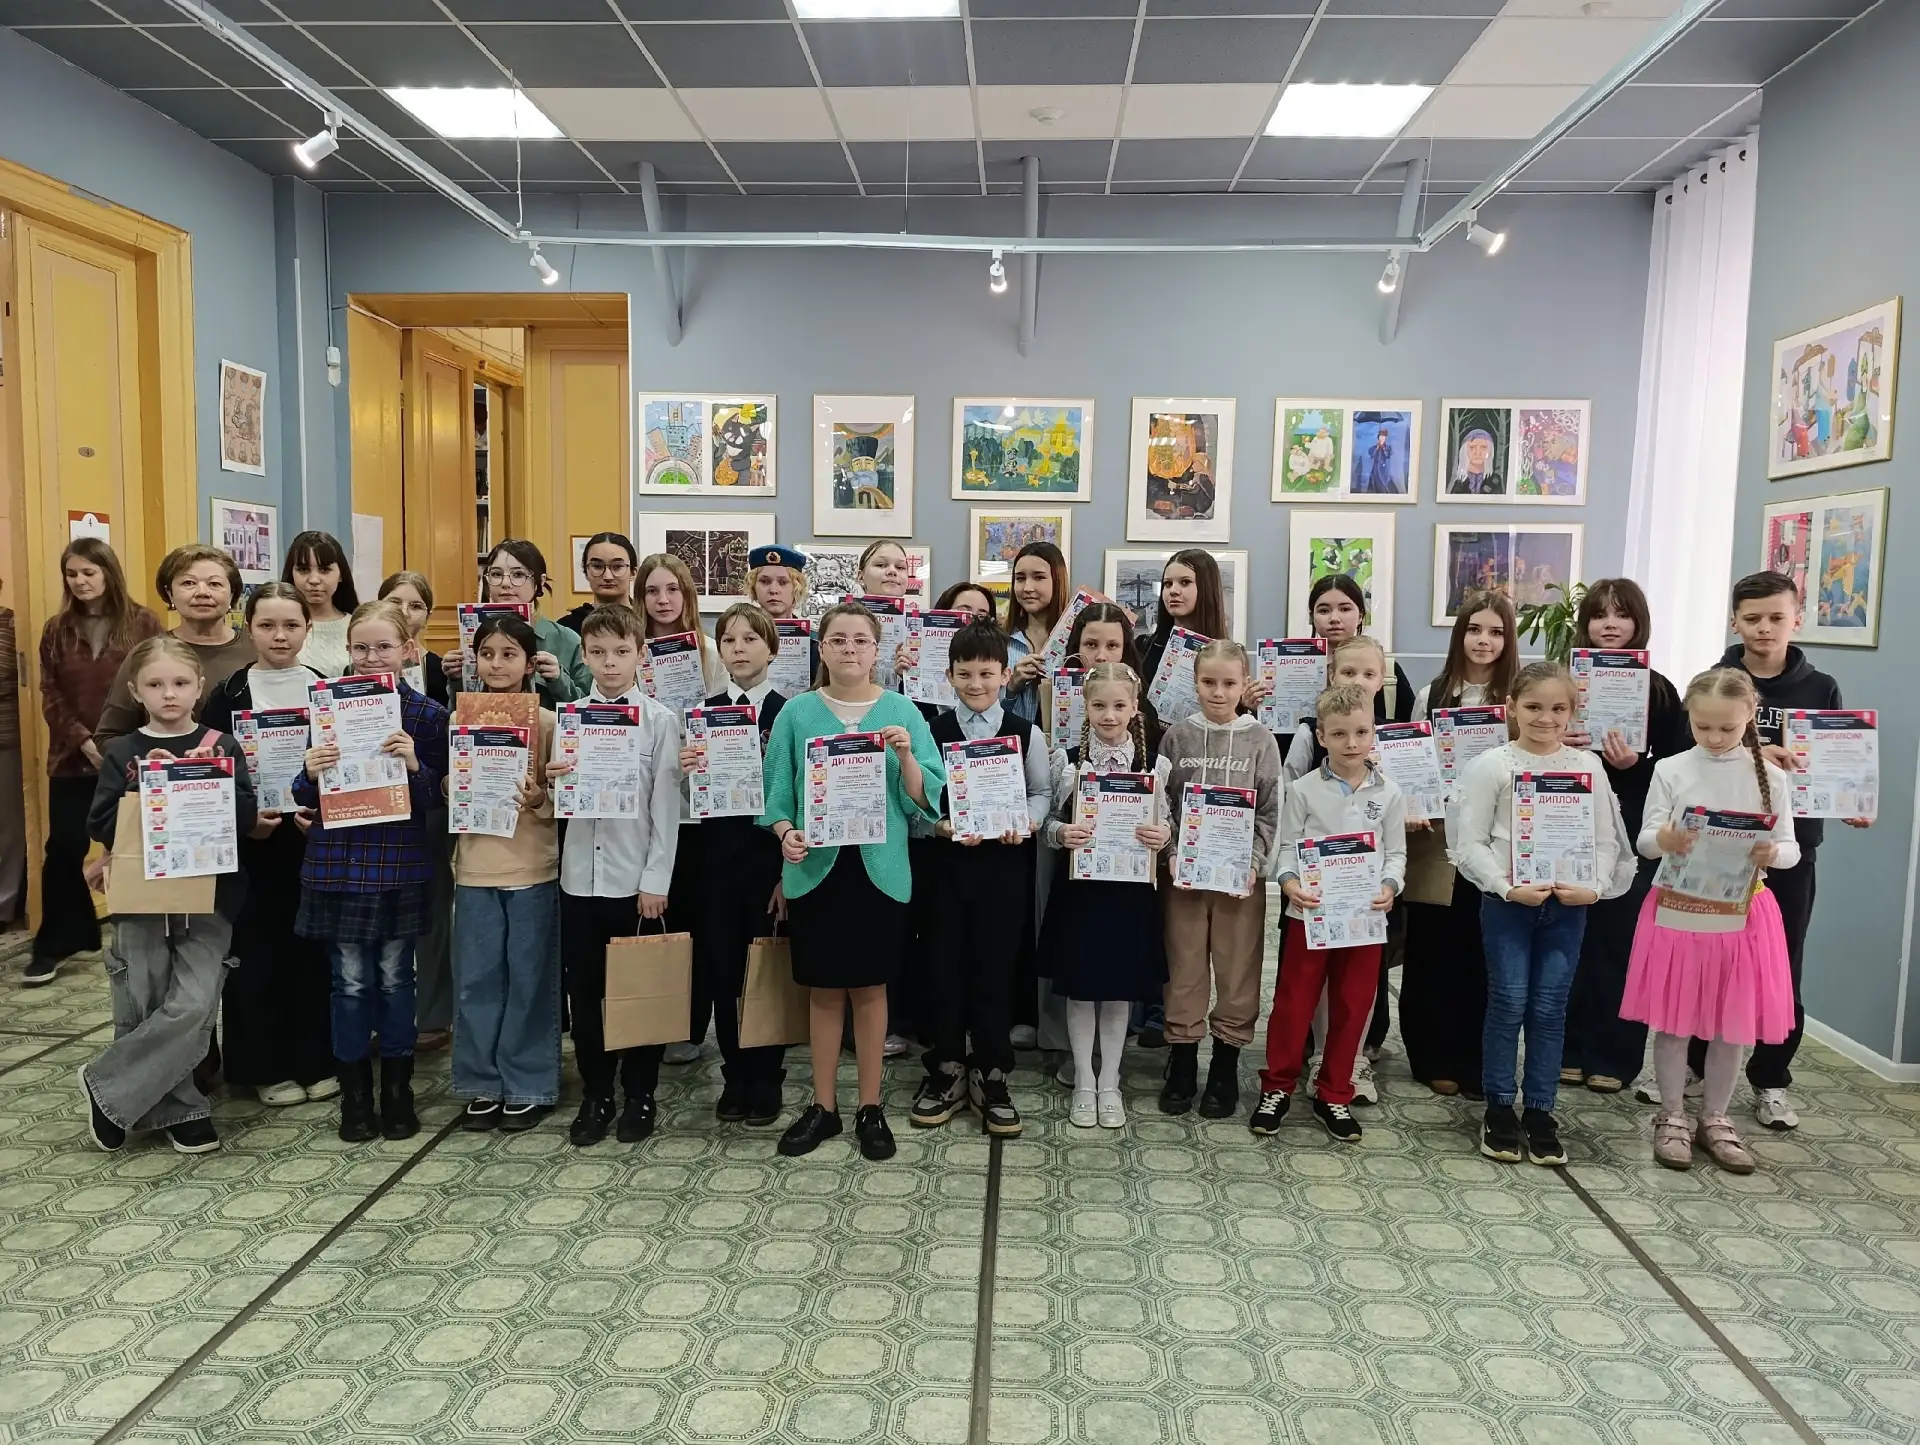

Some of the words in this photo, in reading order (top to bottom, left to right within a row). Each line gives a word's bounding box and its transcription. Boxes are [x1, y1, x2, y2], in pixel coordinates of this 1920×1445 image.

[925, 629, 955, 637] ДИПЛО
[1280, 658, 1316, 666] ДИПЛОМ
[1595, 670, 1636, 678] ДИПЛОМ
[338, 697, 383, 710] ДИПЛОМ
[261, 729, 305, 739] ДИПЛОМ
[583, 727, 627, 736] ДИПЛОМ
[711, 728, 748, 738] ДИПЛОМ
[1457, 727, 1495, 736] ДИПЛОМ
[1383, 740, 1422, 750] ДИПЛОМ
[476, 748, 517, 758] ДИПЛОМ
[969, 757, 1009, 768] ДИПЛОМ
[1179, 756, 1250, 772] essential
[172, 781, 220, 792] ДИПЛОМ
[1102, 794, 1142, 804] ДИПЛОМ
[1538, 795, 1580, 804] ДИПЛОМ
[327, 809, 382, 819] WATER-COLORS
[1206, 807, 1244, 818] ДИПЛОМ
[1707, 828, 1757, 839] ДИПЛОМ
[1324, 855, 1366, 868] ДИПЛОМ
